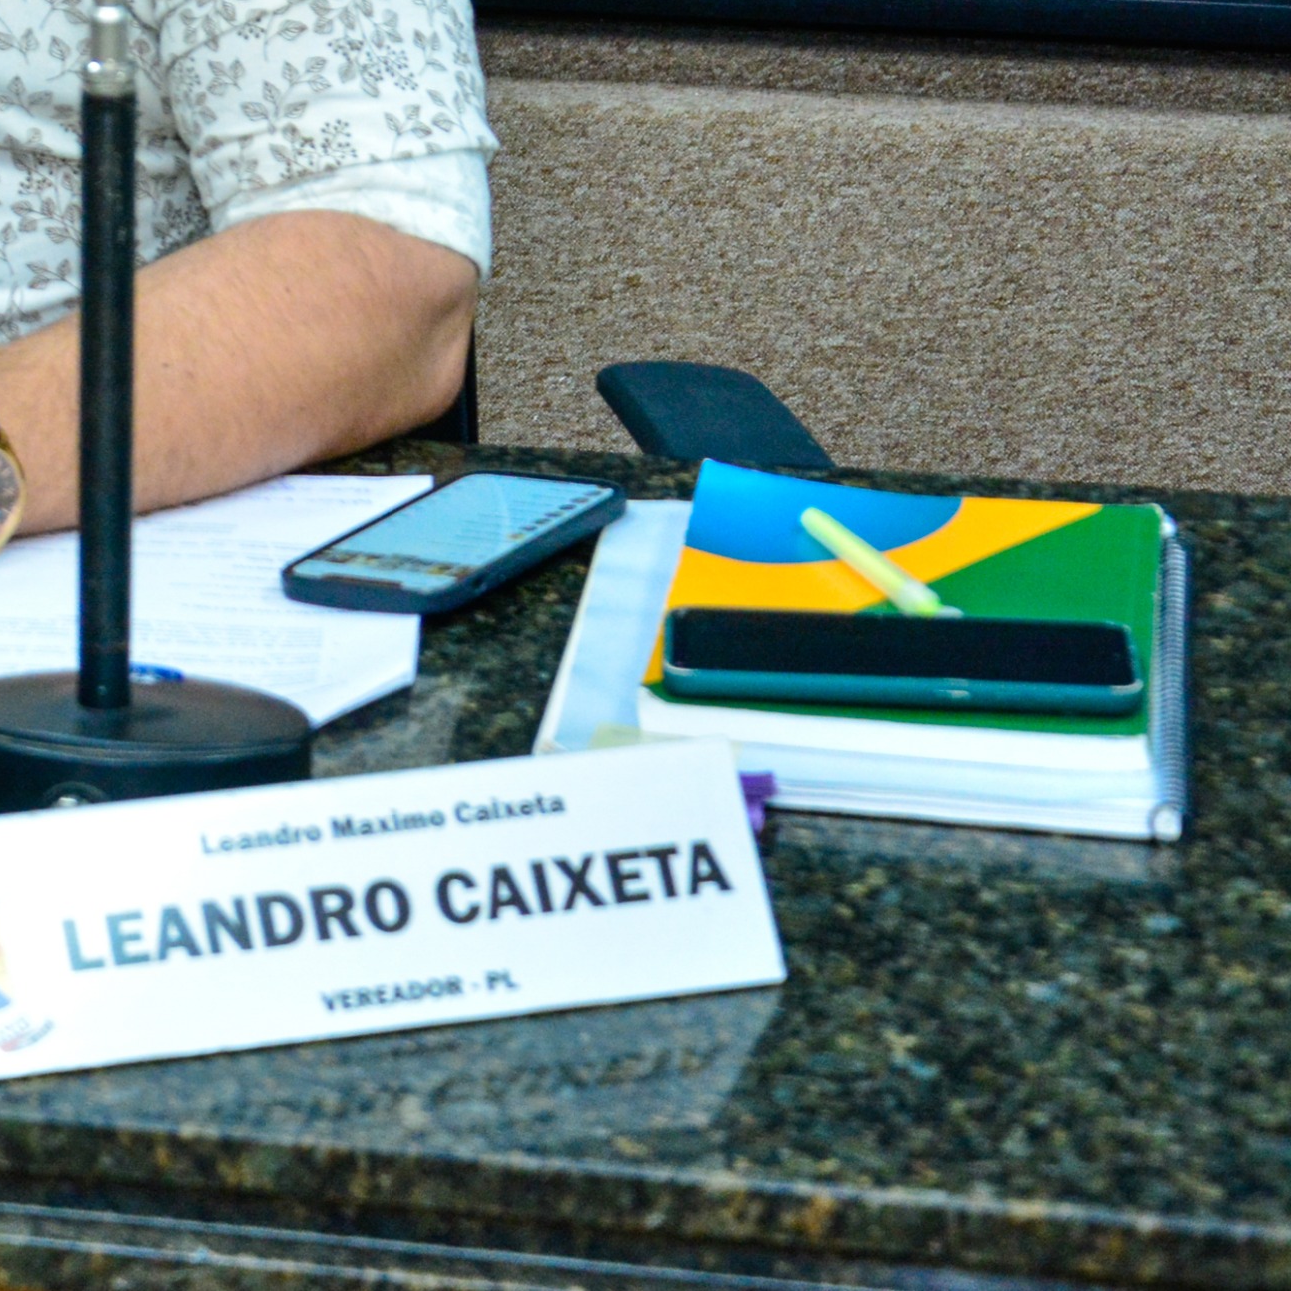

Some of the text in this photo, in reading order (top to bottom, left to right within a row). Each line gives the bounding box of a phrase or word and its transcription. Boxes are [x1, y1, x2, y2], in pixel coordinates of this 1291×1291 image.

[201, 792, 566, 854] Leandro Maximo Caixeta
[63, 839, 735, 971] LEANDRO CAIXETA
[320, 974, 464, 1011] VEREADOR
[484, 969, 519, 991] PL
